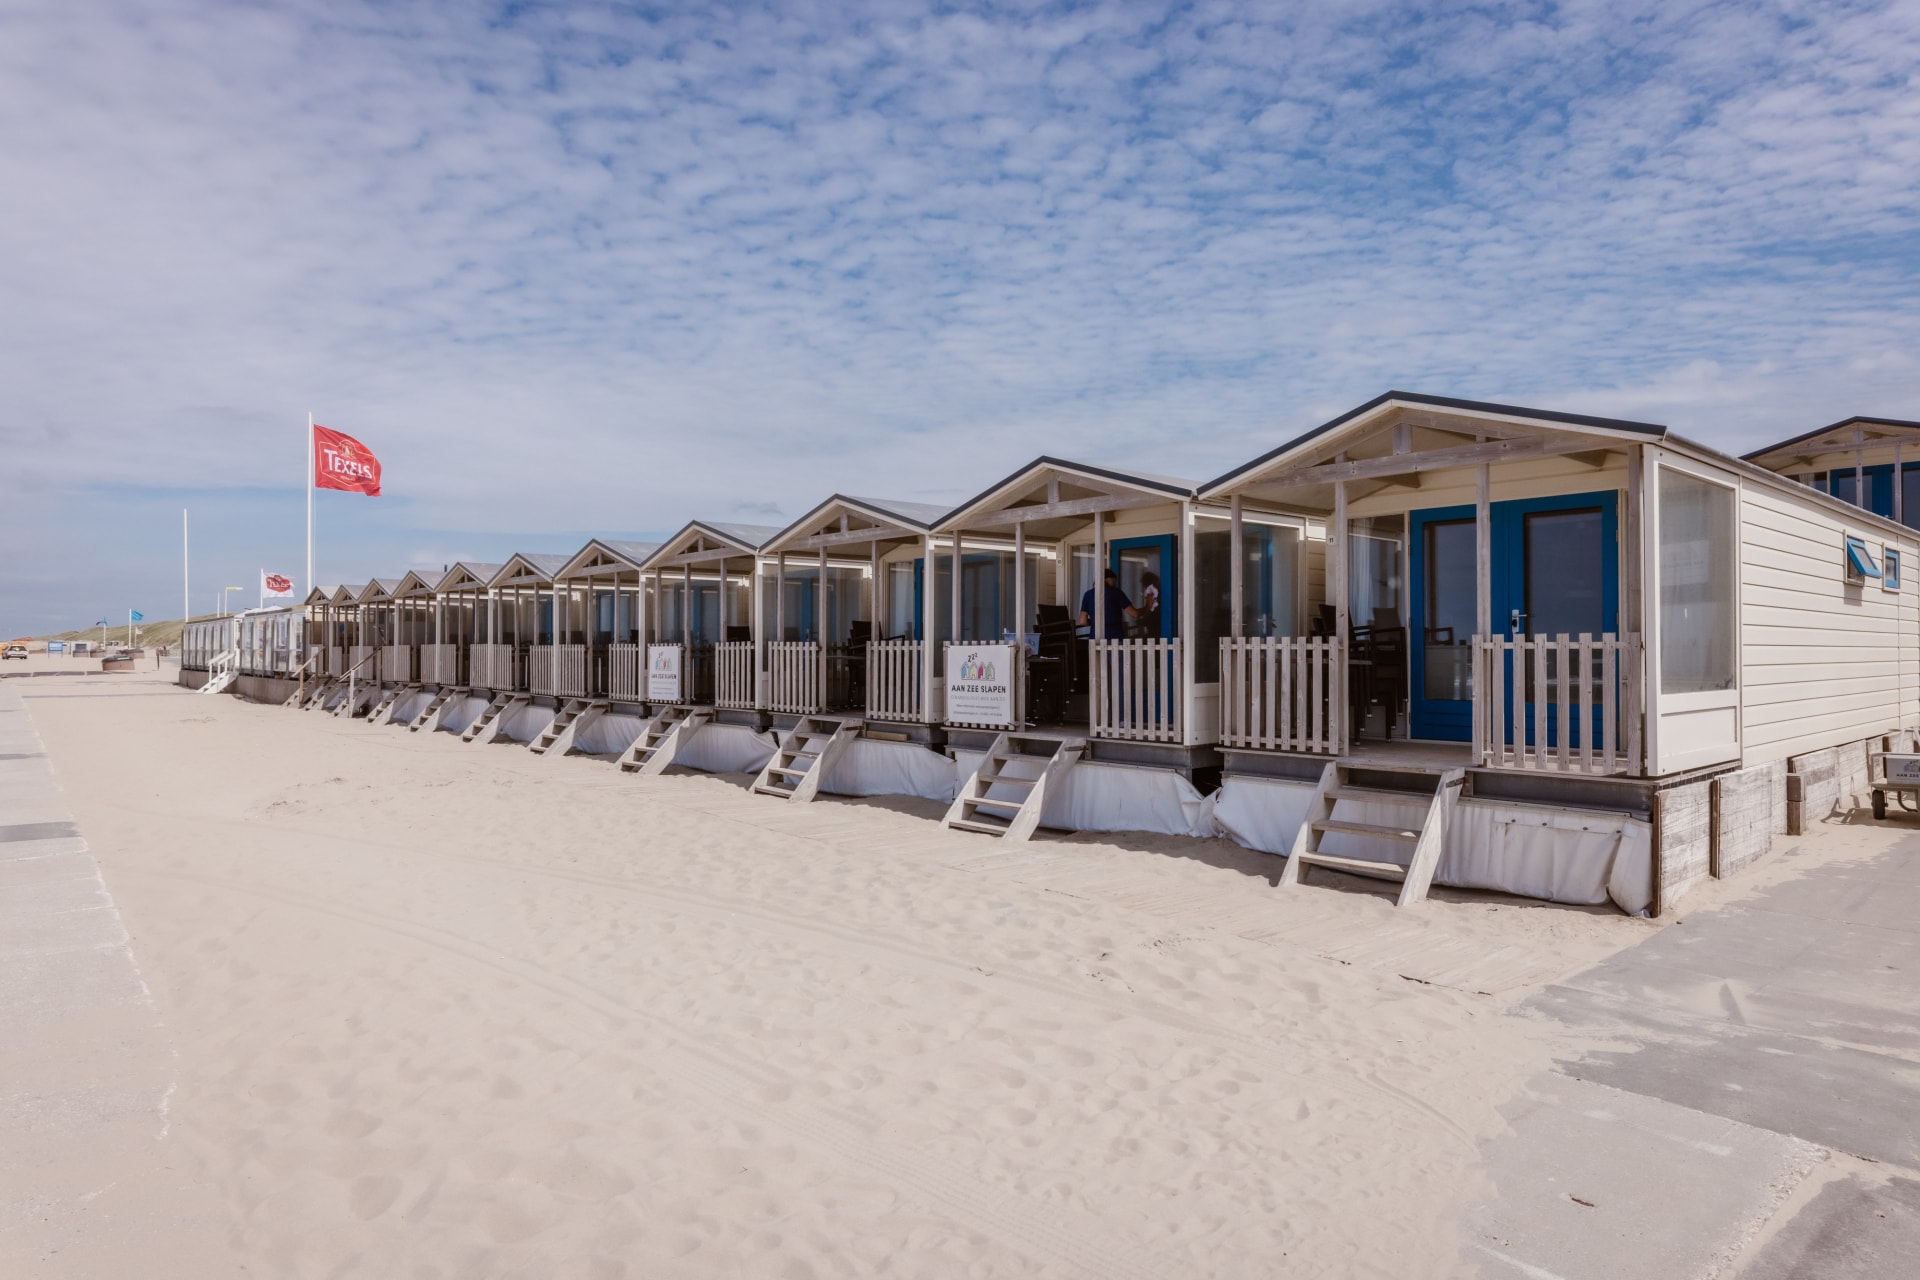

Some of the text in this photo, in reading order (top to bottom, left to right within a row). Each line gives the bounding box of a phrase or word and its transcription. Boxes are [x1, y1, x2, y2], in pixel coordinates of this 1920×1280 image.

[323, 448, 373, 479] TEXELS
[951, 684, 965, 692] AAN
[967, 685, 979, 693] ZEE
